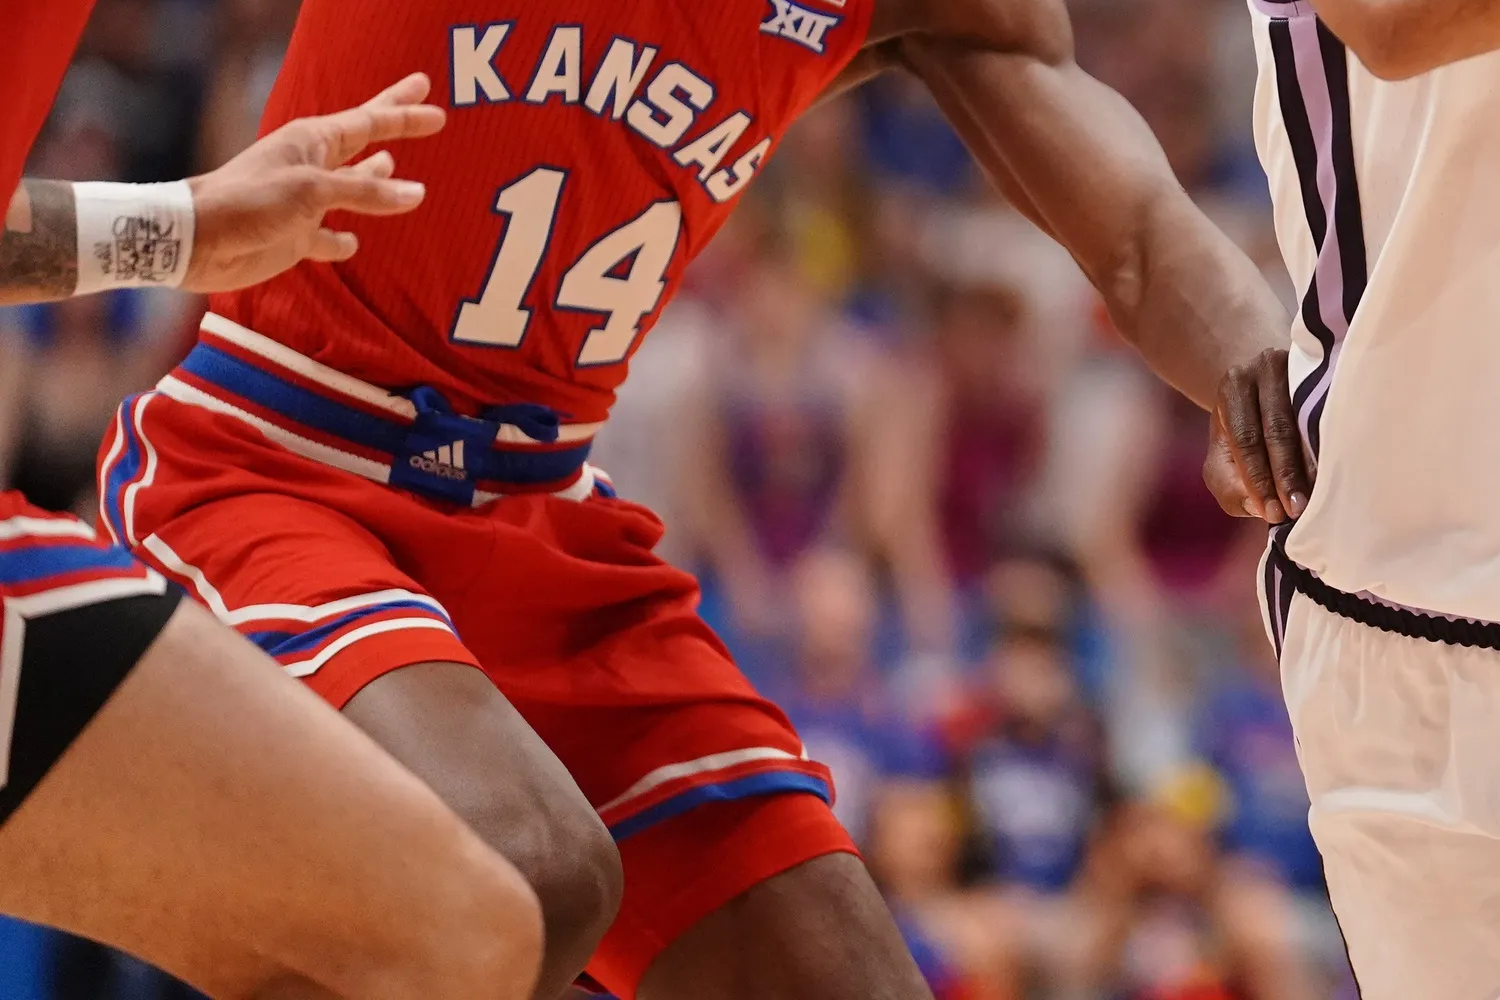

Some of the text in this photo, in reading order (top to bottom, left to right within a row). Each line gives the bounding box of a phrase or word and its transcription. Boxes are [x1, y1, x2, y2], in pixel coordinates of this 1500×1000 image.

[450, 20, 773, 203] KANSAS
[450, 164, 683, 370] 14
[409, 455, 467, 480] adidas
